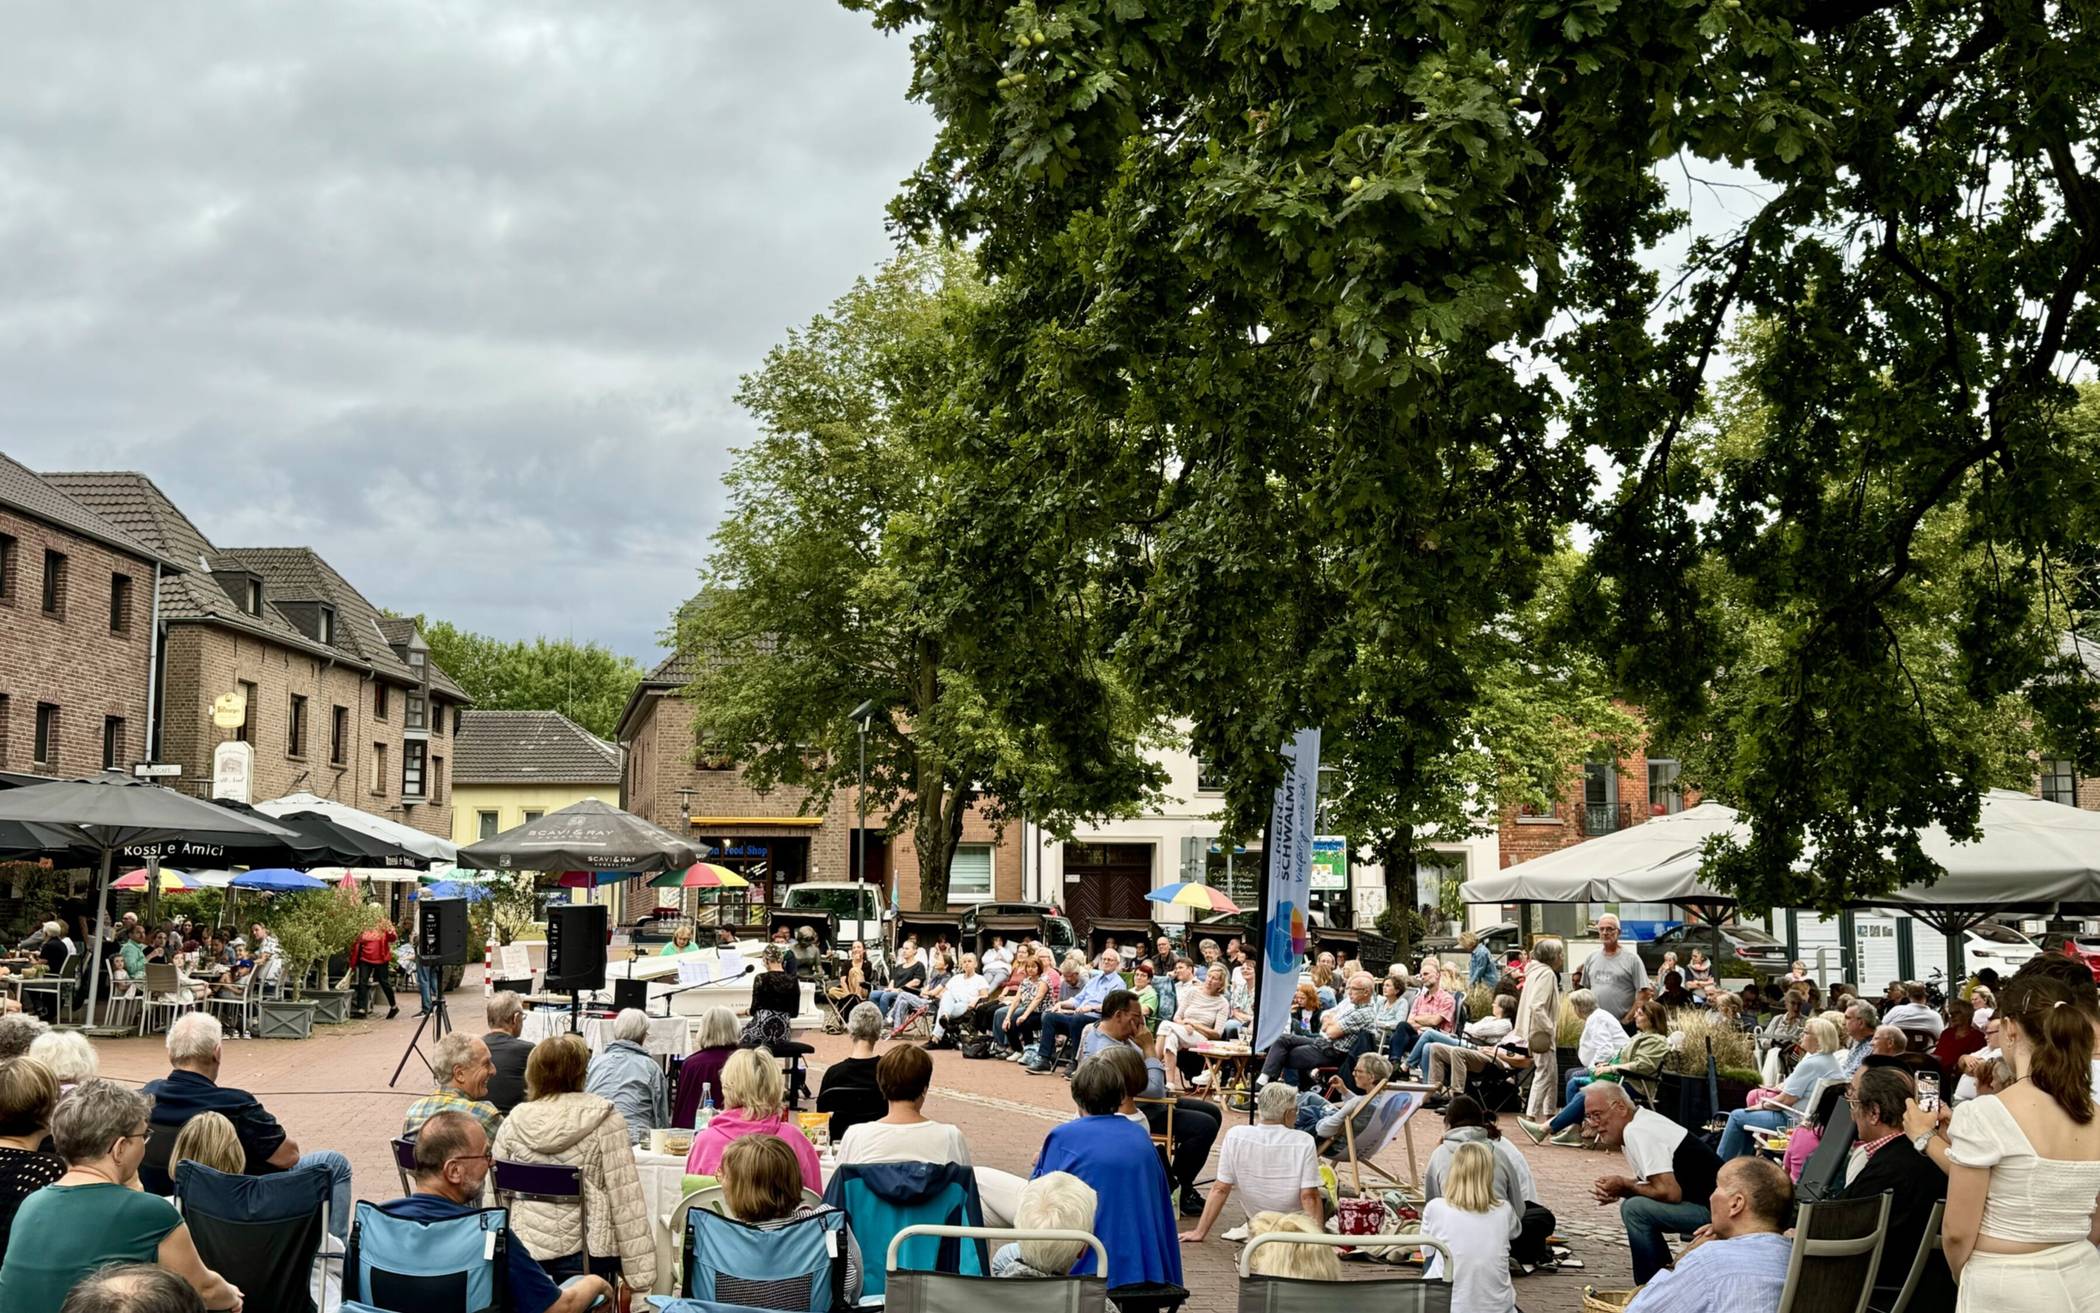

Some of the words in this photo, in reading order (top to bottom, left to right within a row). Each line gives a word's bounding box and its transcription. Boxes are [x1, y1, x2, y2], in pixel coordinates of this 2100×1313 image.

[124, 843, 161, 856] Rossi
[167, 844, 176, 854] e
[182, 842, 224, 856] Amici
[1281, 753, 1297, 882] SCHWALMTAL
